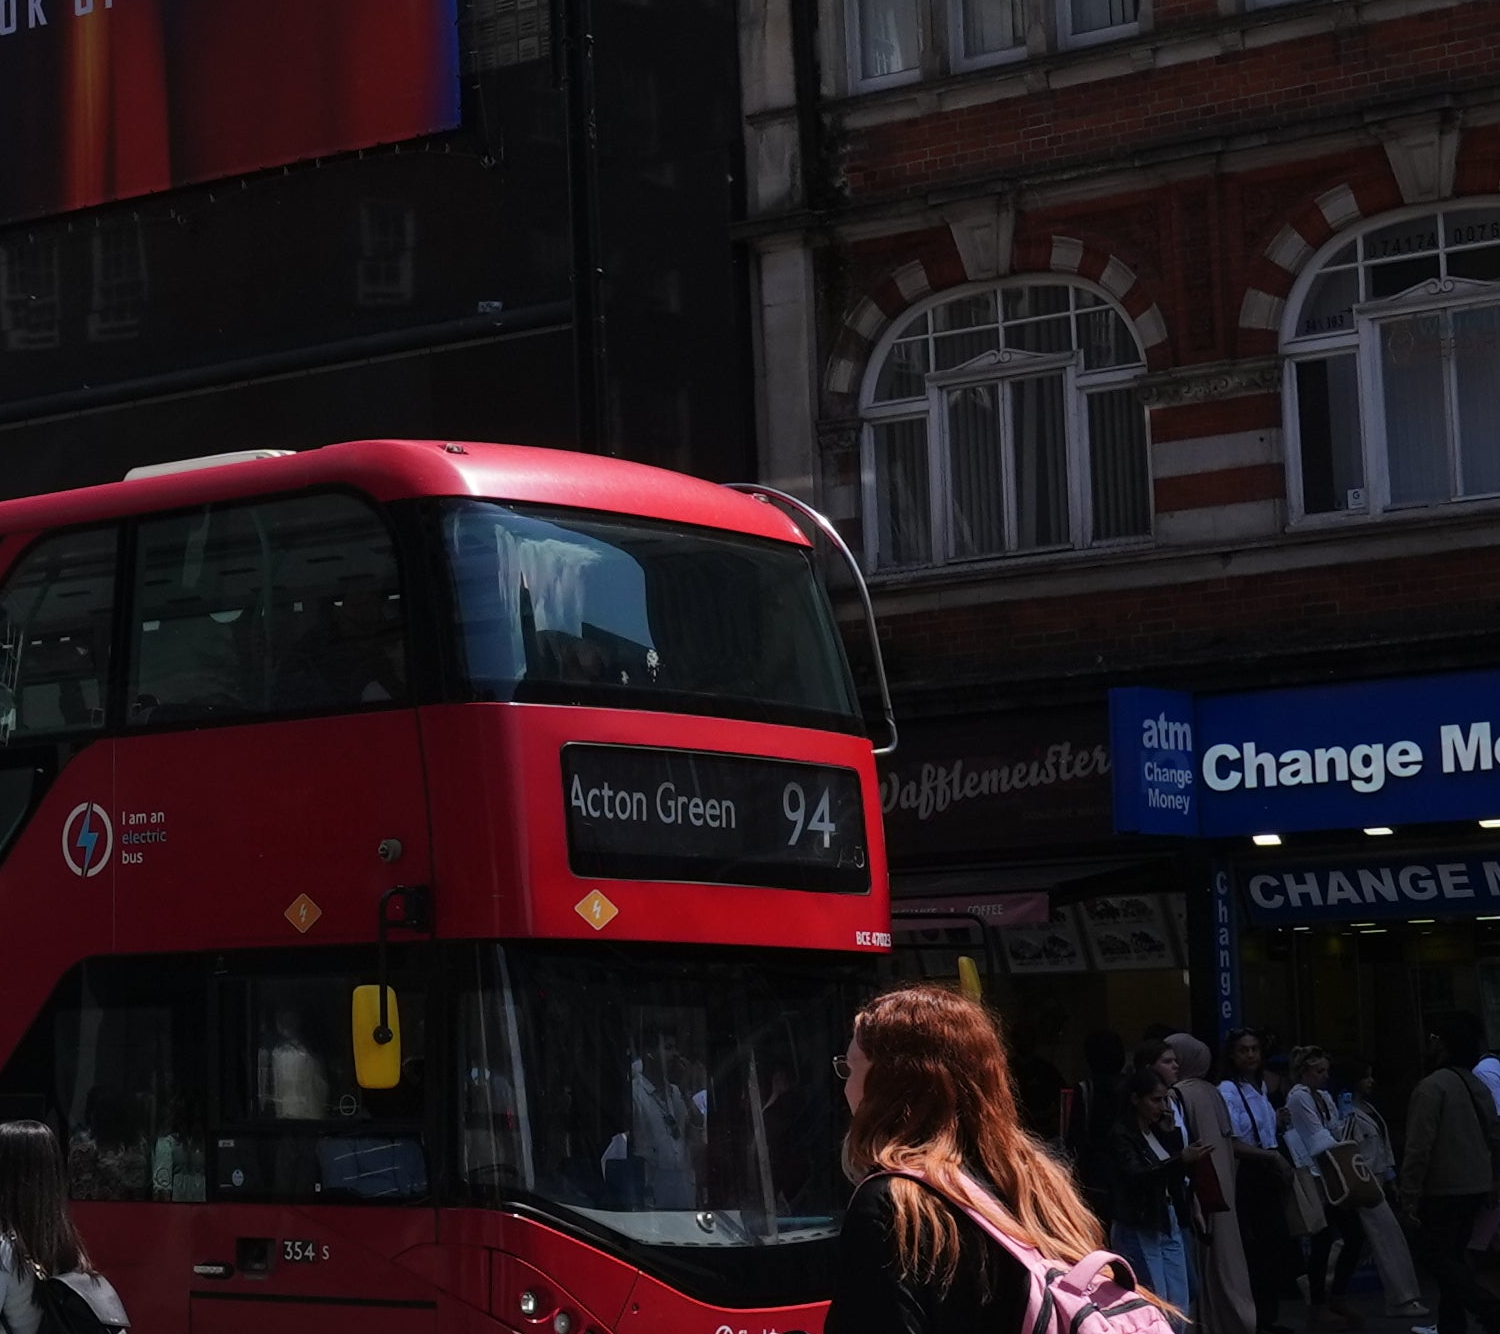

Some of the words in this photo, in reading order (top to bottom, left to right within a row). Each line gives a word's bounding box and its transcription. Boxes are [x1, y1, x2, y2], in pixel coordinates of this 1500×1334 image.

[1142, 711, 1193, 752] atm
[1144, 760, 1193, 786] Change
[1201, 739, 1423, 794] Change
[569, 773, 648, 822] Acton
[655, 781, 737, 830] Green
[782, 780, 837, 849] 94
[1148, 787, 1191, 816] Money
[128, 814, 148, 826] am
[150, 812, 166, 824] an
[121, 828, 168, 845] electric
[121, 849, 144, 866] bus
[1248, 863, 1476, 911] CHANGE
[966, 903, 1004, 917] COFFEE
[855, 930, 871, 947] BCE
[1214, 869, 1233, 1020] Change
[283, 1240, 315, 1261] 354
